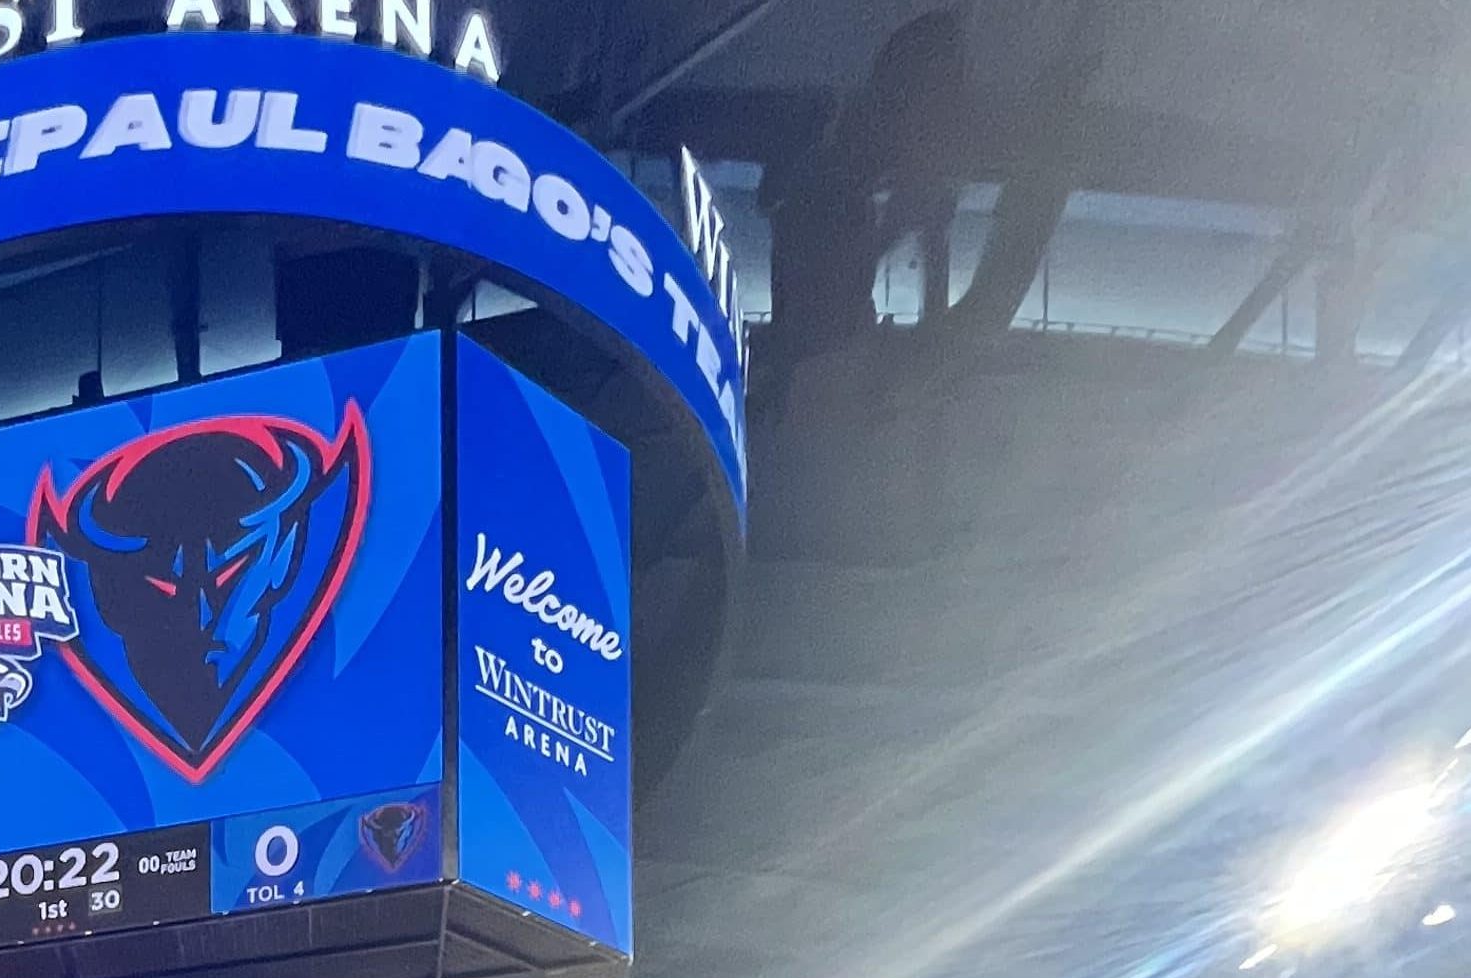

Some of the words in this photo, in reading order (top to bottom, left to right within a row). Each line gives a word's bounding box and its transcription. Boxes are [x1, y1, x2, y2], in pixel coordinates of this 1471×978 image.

[466, 532, 623, 661] Welcome
[531, 637, 564, 674] to
[475, 645, 614, 752] WINTRUST
[505, 716, 587, 776] ARENA
[139, 855, 160, 874] 00
[160, 860, 196, 875] FOULS
[165, 848, 197, 862] TEAM
[255, 826, 299, 876] 0
[38, 899, 68, 920] 1st
[91, 890, 120, 911] 30
[247, 885, 284, 903] TOL
[293, 881, 304, 896] 4
